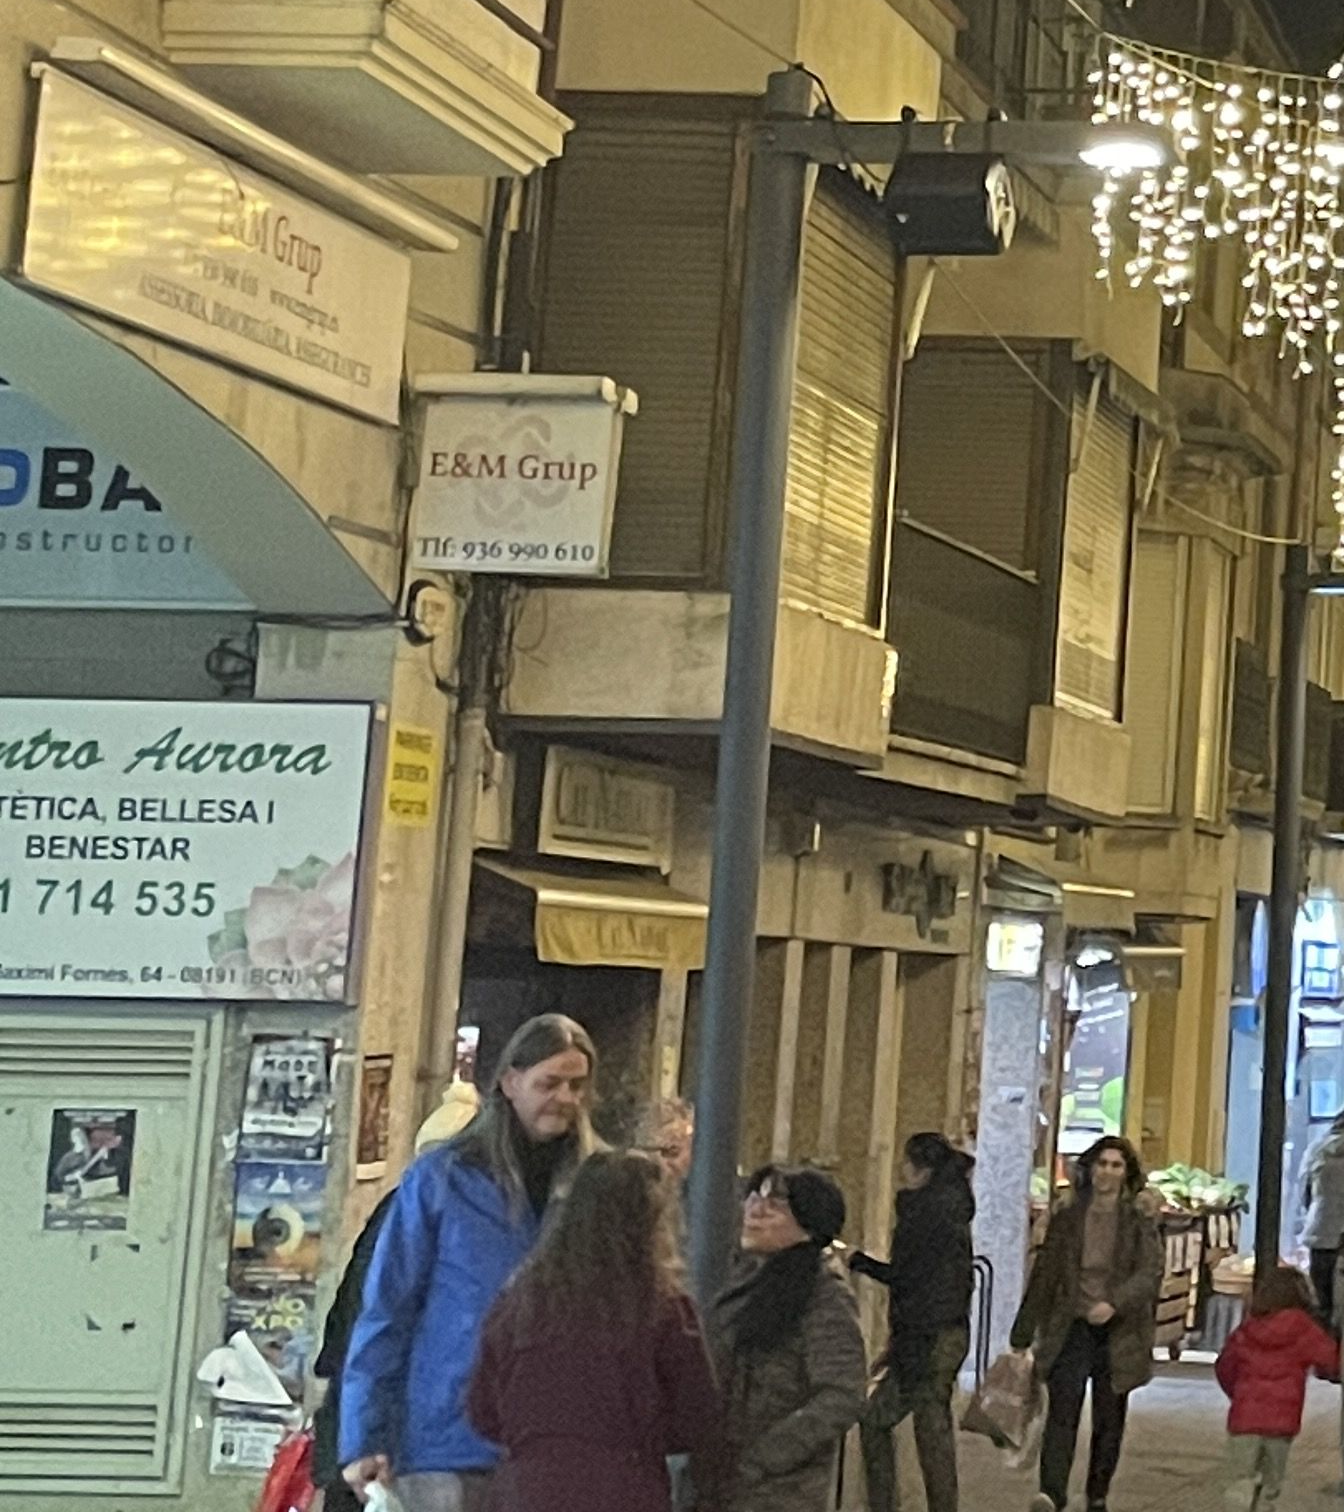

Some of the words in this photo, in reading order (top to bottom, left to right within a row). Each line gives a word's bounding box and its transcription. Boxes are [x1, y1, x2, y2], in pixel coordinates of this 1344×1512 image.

[273, 215, 322, 295] Grup
[430, 452, 507, 479] E&M
[518, 454, 598, 490] Grup
[462, 541, 503, 561] 936
[509, 542, 549, 562] 990
[554, 543, 595, 562] 610
[123, 726, 332, 776] Aurora
[117, 797, 259, 824] BELLESA
[266, 799, 275, 824] I
[25, 835, 191, 862] BENESTAR
[36, 879, 115, 916] 714
[134, 881, 216, 917] 535
[140, 966, 163, 983] 64
